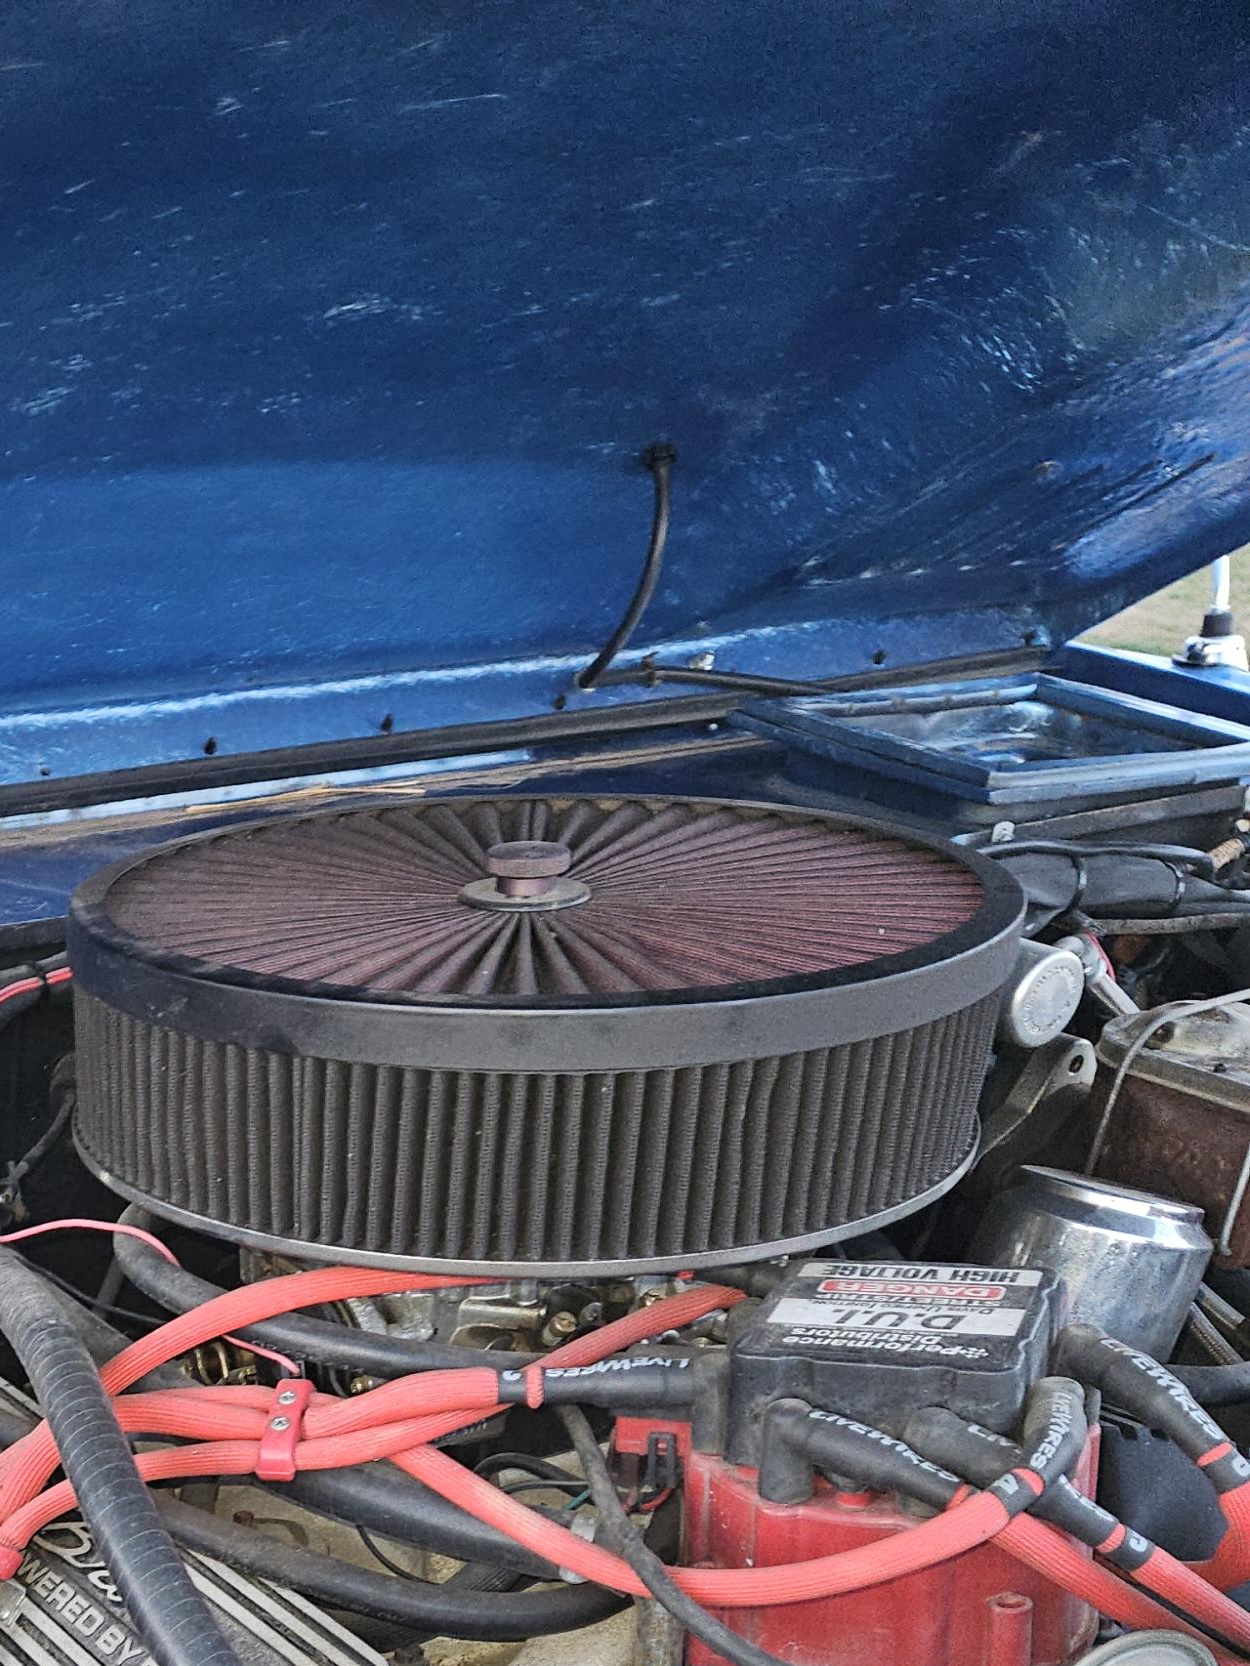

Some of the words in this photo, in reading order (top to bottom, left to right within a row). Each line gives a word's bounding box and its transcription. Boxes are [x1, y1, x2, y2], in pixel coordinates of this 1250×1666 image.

[820, 1265, 938, 1279] VOLTAGE
[951, 1269, 1018, 1282] HIGH
[835, 1281, 989, 1296] DANGER
[814, 1293, 1000, 1306] STREET/STRIP
[831, 1308, 966, 1329] D.U.I.
[790, 1327, 940, 1344] Distributors
[781, 1335, 962, 1355] Performance
[6, 1540, 107, 1644] WERED
